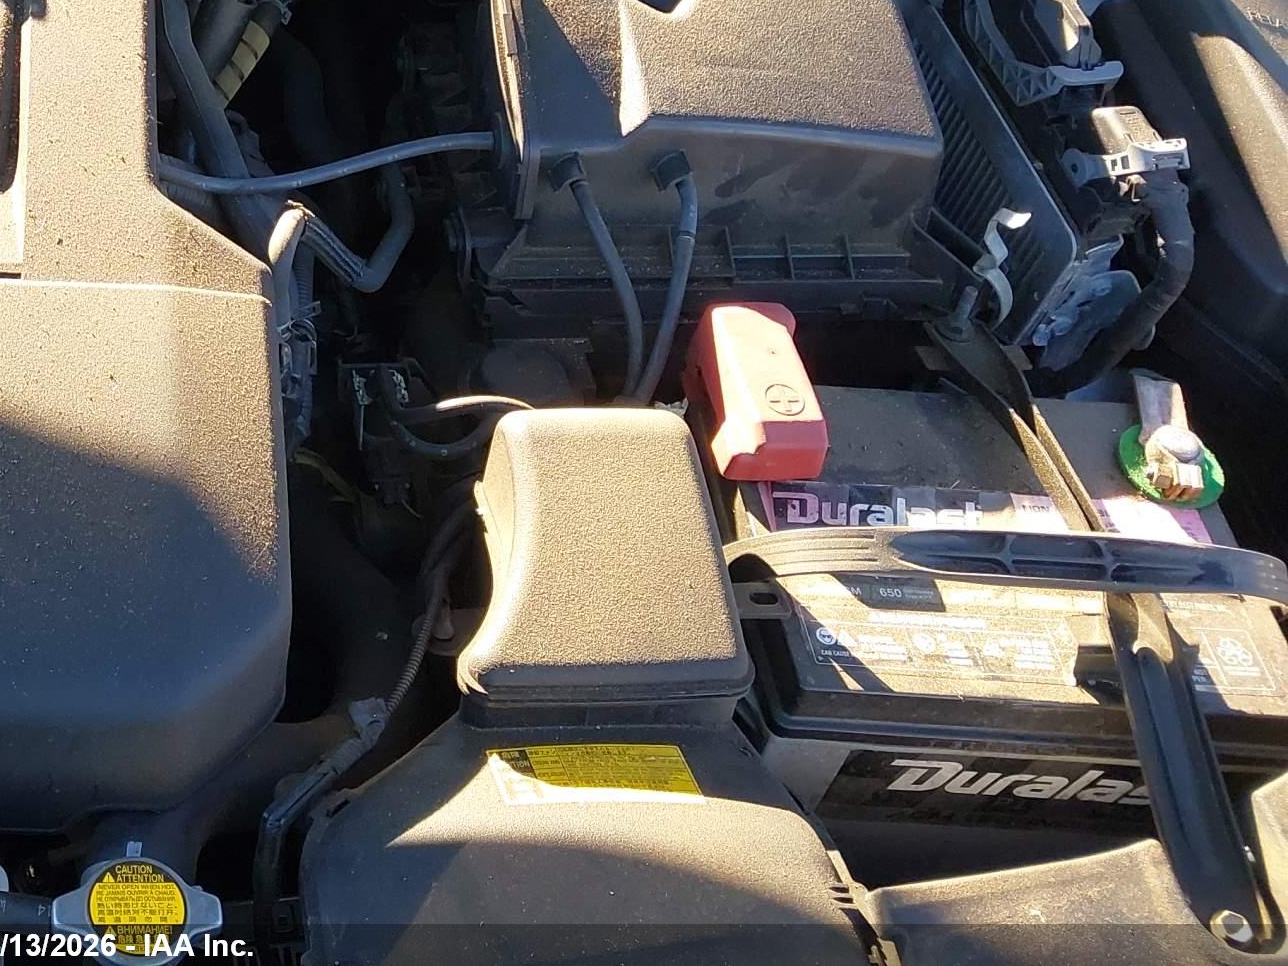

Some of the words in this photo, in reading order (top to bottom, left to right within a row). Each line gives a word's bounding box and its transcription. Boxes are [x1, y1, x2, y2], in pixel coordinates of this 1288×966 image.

[772, 491, 984, 527] Duralast
[879, 587, 902, 598] 650
[886, 758, 1152, 805] Duralas
[115, 865, 152, 874] CAUTION
[116, 874, 164, 883] ATTENTION
